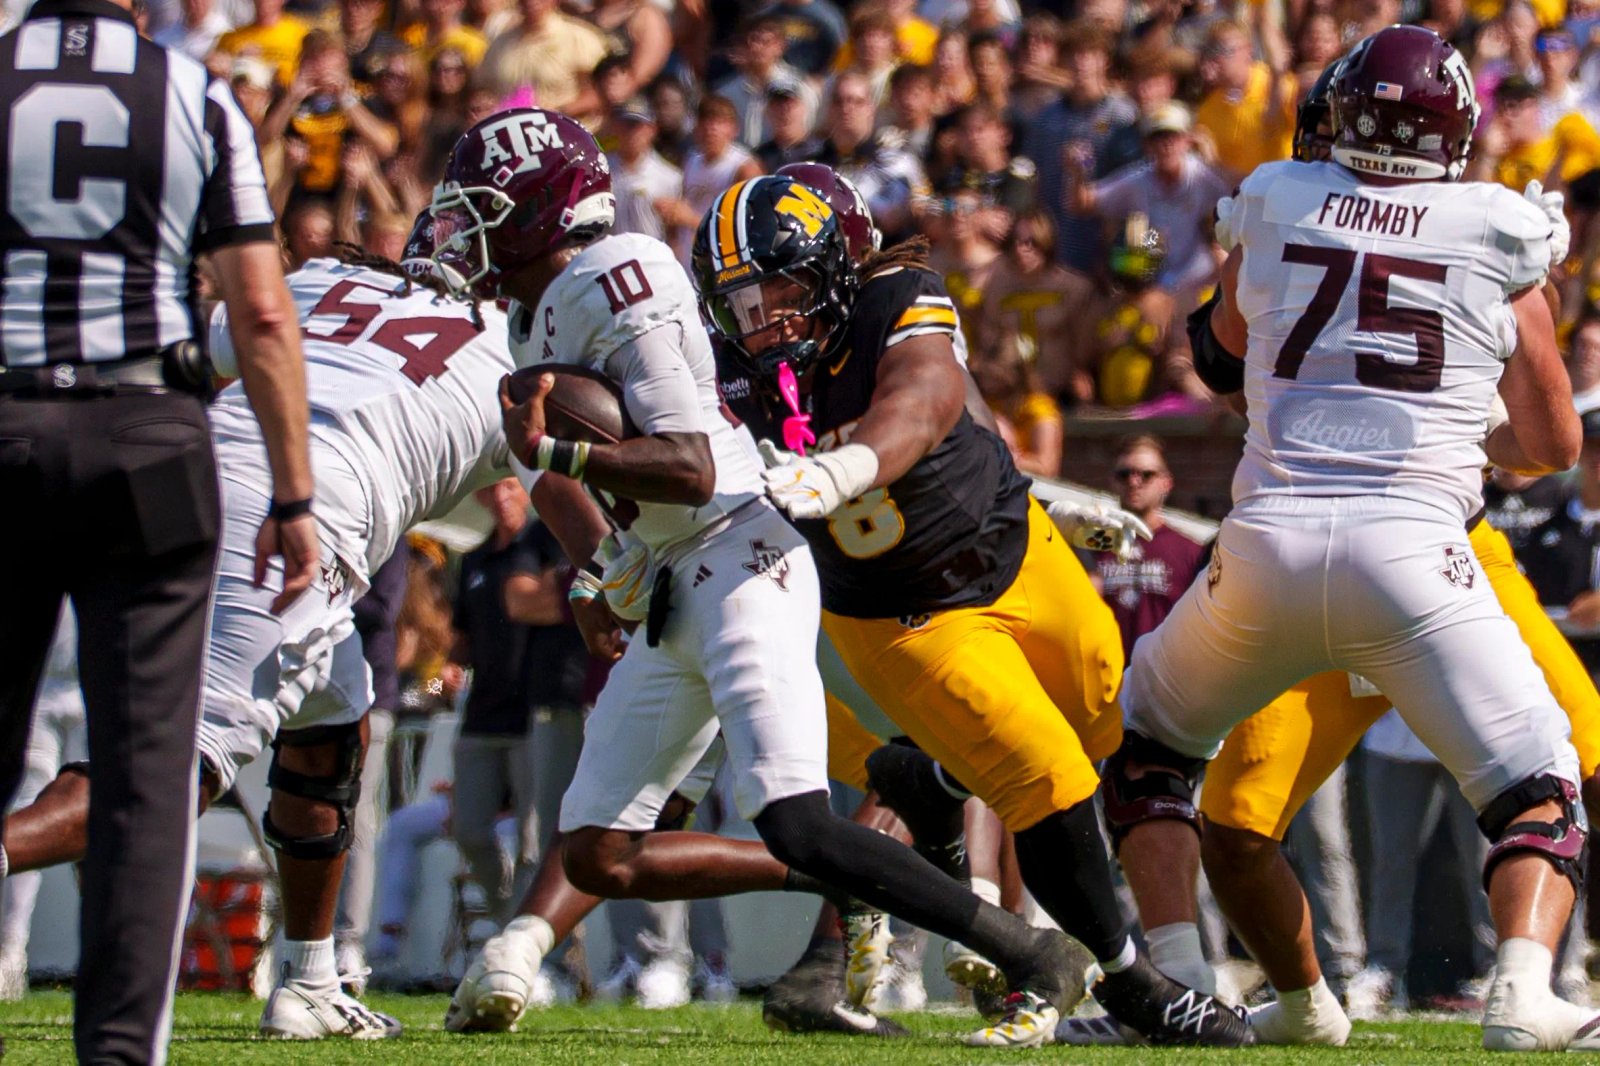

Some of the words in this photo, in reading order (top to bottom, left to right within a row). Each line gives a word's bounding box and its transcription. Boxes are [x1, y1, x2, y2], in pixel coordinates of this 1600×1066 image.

[8, 82, 131, 240] C
[1350, 156, 1387, 173] TEXAS
[1376, 143, 1392, 156] 75
[774, 182, 834, 239] M
[1318, 192, 1429, 238] FORMBY
[594, 258, 654, 316] 10
[301, 279, 487, 388] 54
[545, 306, 556, 337] C
[1272, 242, 1448, 393] 75
[1282, 408, 1394, 455] Aggies
[828, 486, 905, 560] 8
